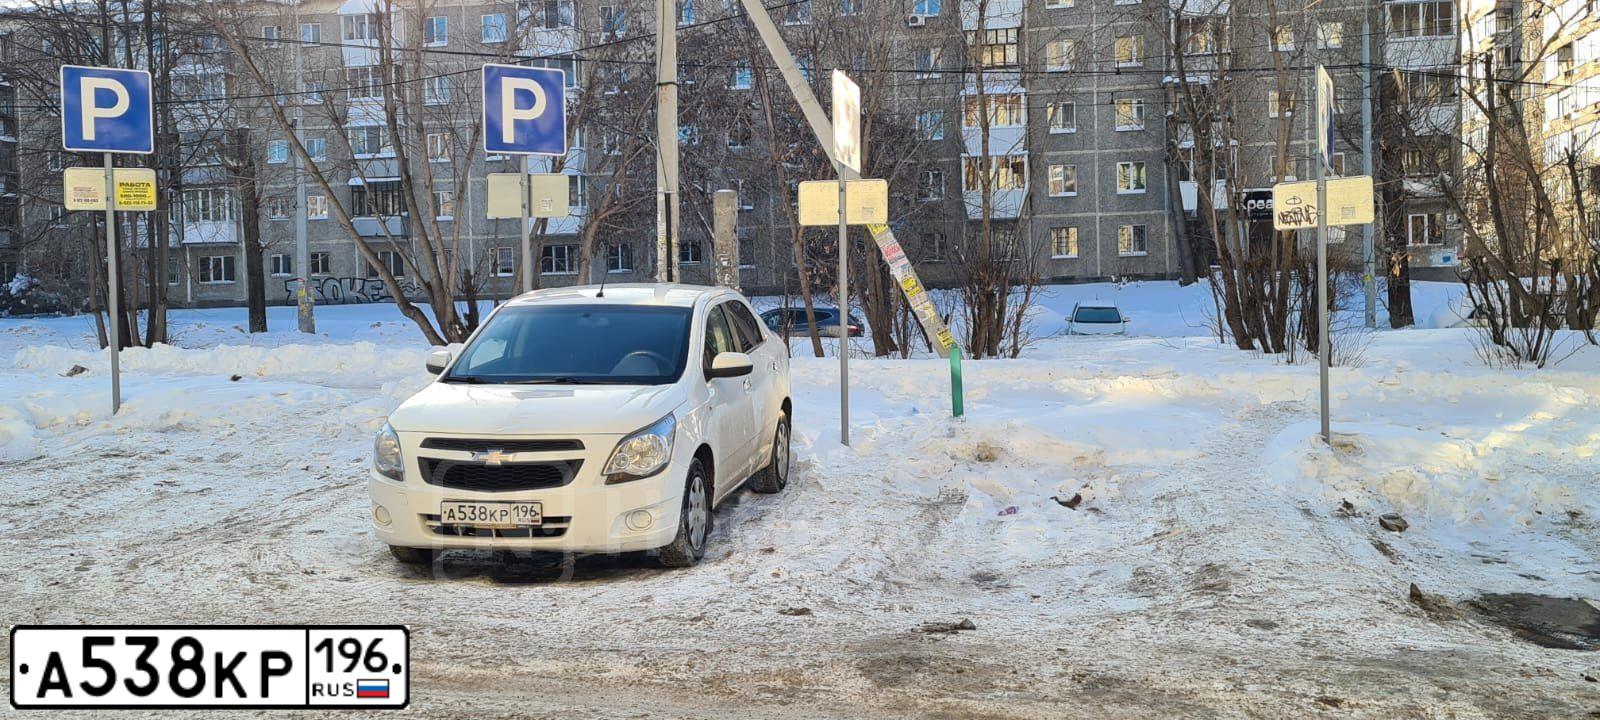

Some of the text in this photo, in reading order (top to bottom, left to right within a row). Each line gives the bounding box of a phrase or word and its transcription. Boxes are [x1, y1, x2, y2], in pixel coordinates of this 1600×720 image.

[80, 76, 130, 141] P
[501, 77, 547, 144] P
[512, 505, 537, 518] 196
